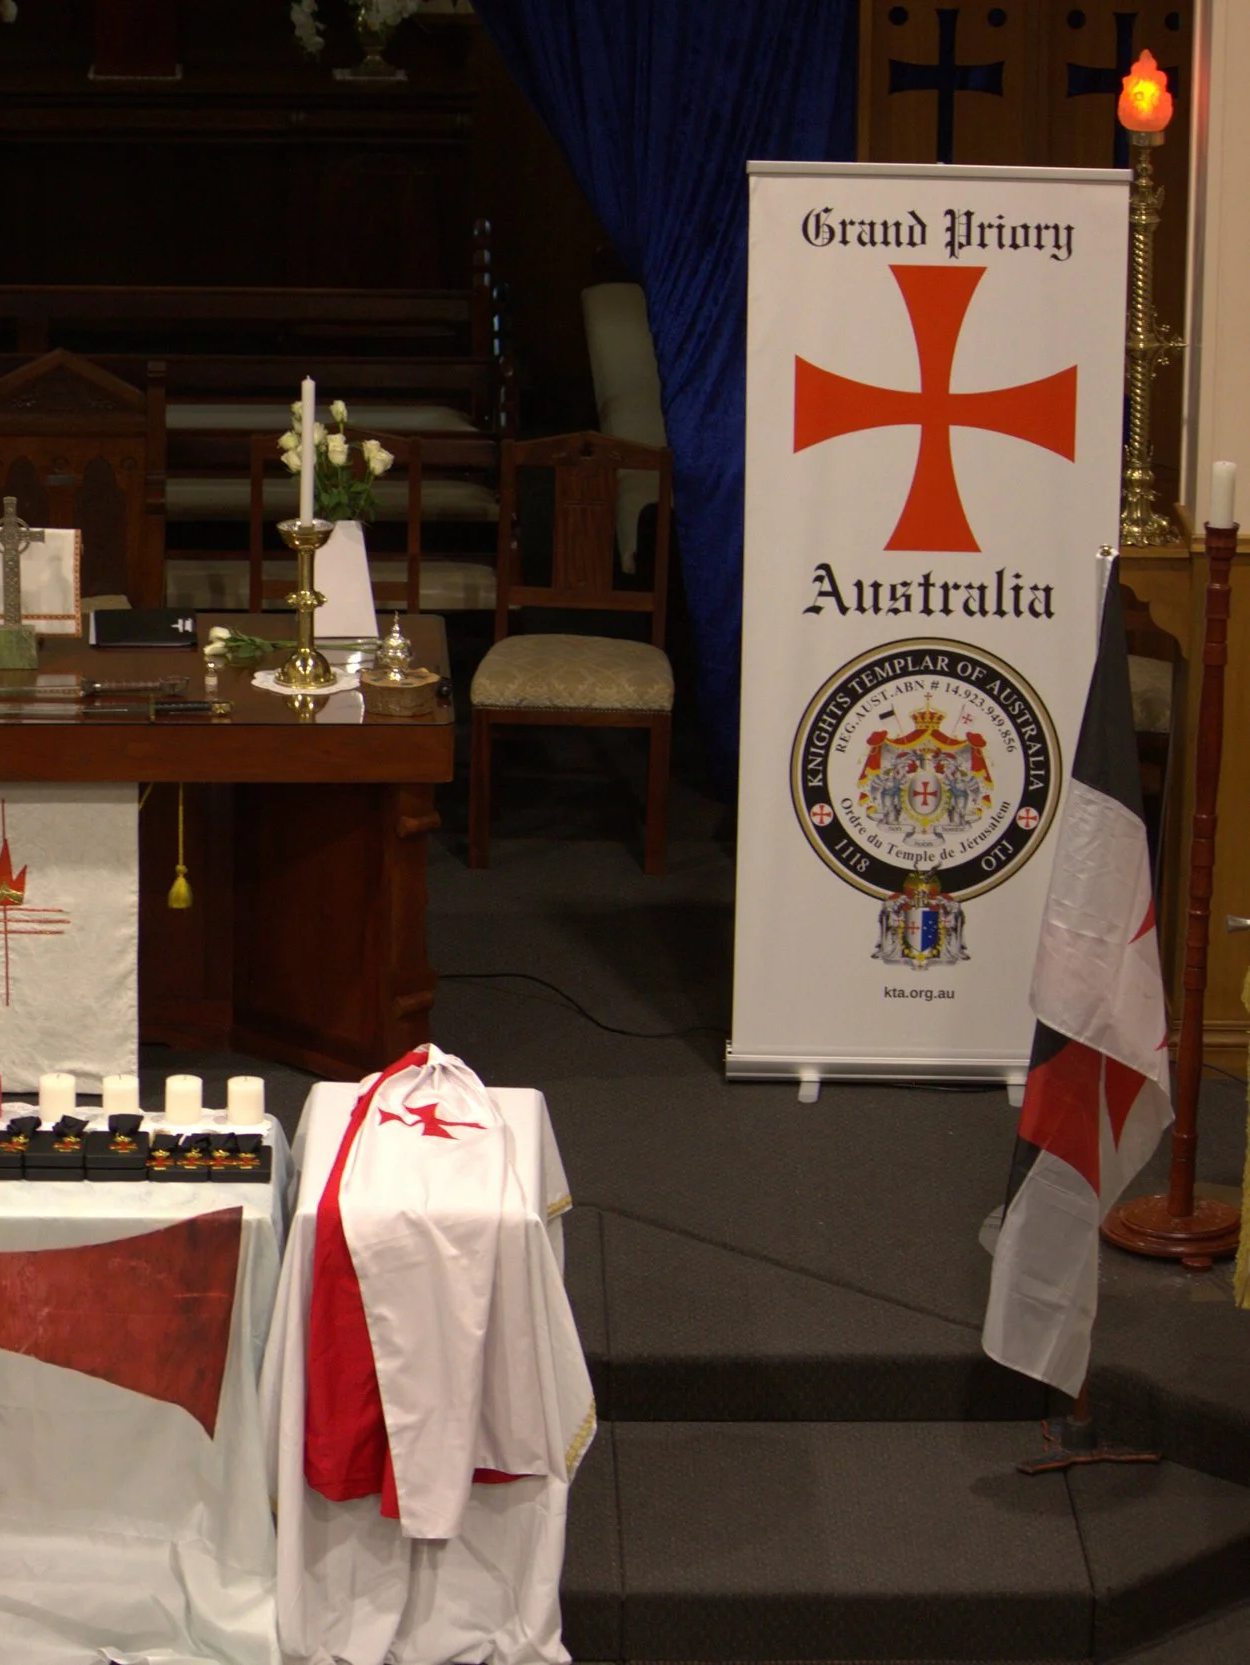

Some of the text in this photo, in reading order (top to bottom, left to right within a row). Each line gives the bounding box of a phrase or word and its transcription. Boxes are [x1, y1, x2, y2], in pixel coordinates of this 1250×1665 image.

[801, 206, 1075, 261] Grand Priory
[802, 563, 1056, 620] Australia
[807, 655, 1045, 791] KNIGHTS TEMPLAR OF AUSTRALIA
[835, 680, 925, 754] REG.AUST.ABN
[944, 683, 1017, 753] 14.923.949.856
[834, 839, 870, 872] 1118
[840, 797, 1011, 864] Ordre du Temple de Jérusalem
[980, 840, 1014, 871] OTJ
[884, 986, 955, 1001] kta.org.au
